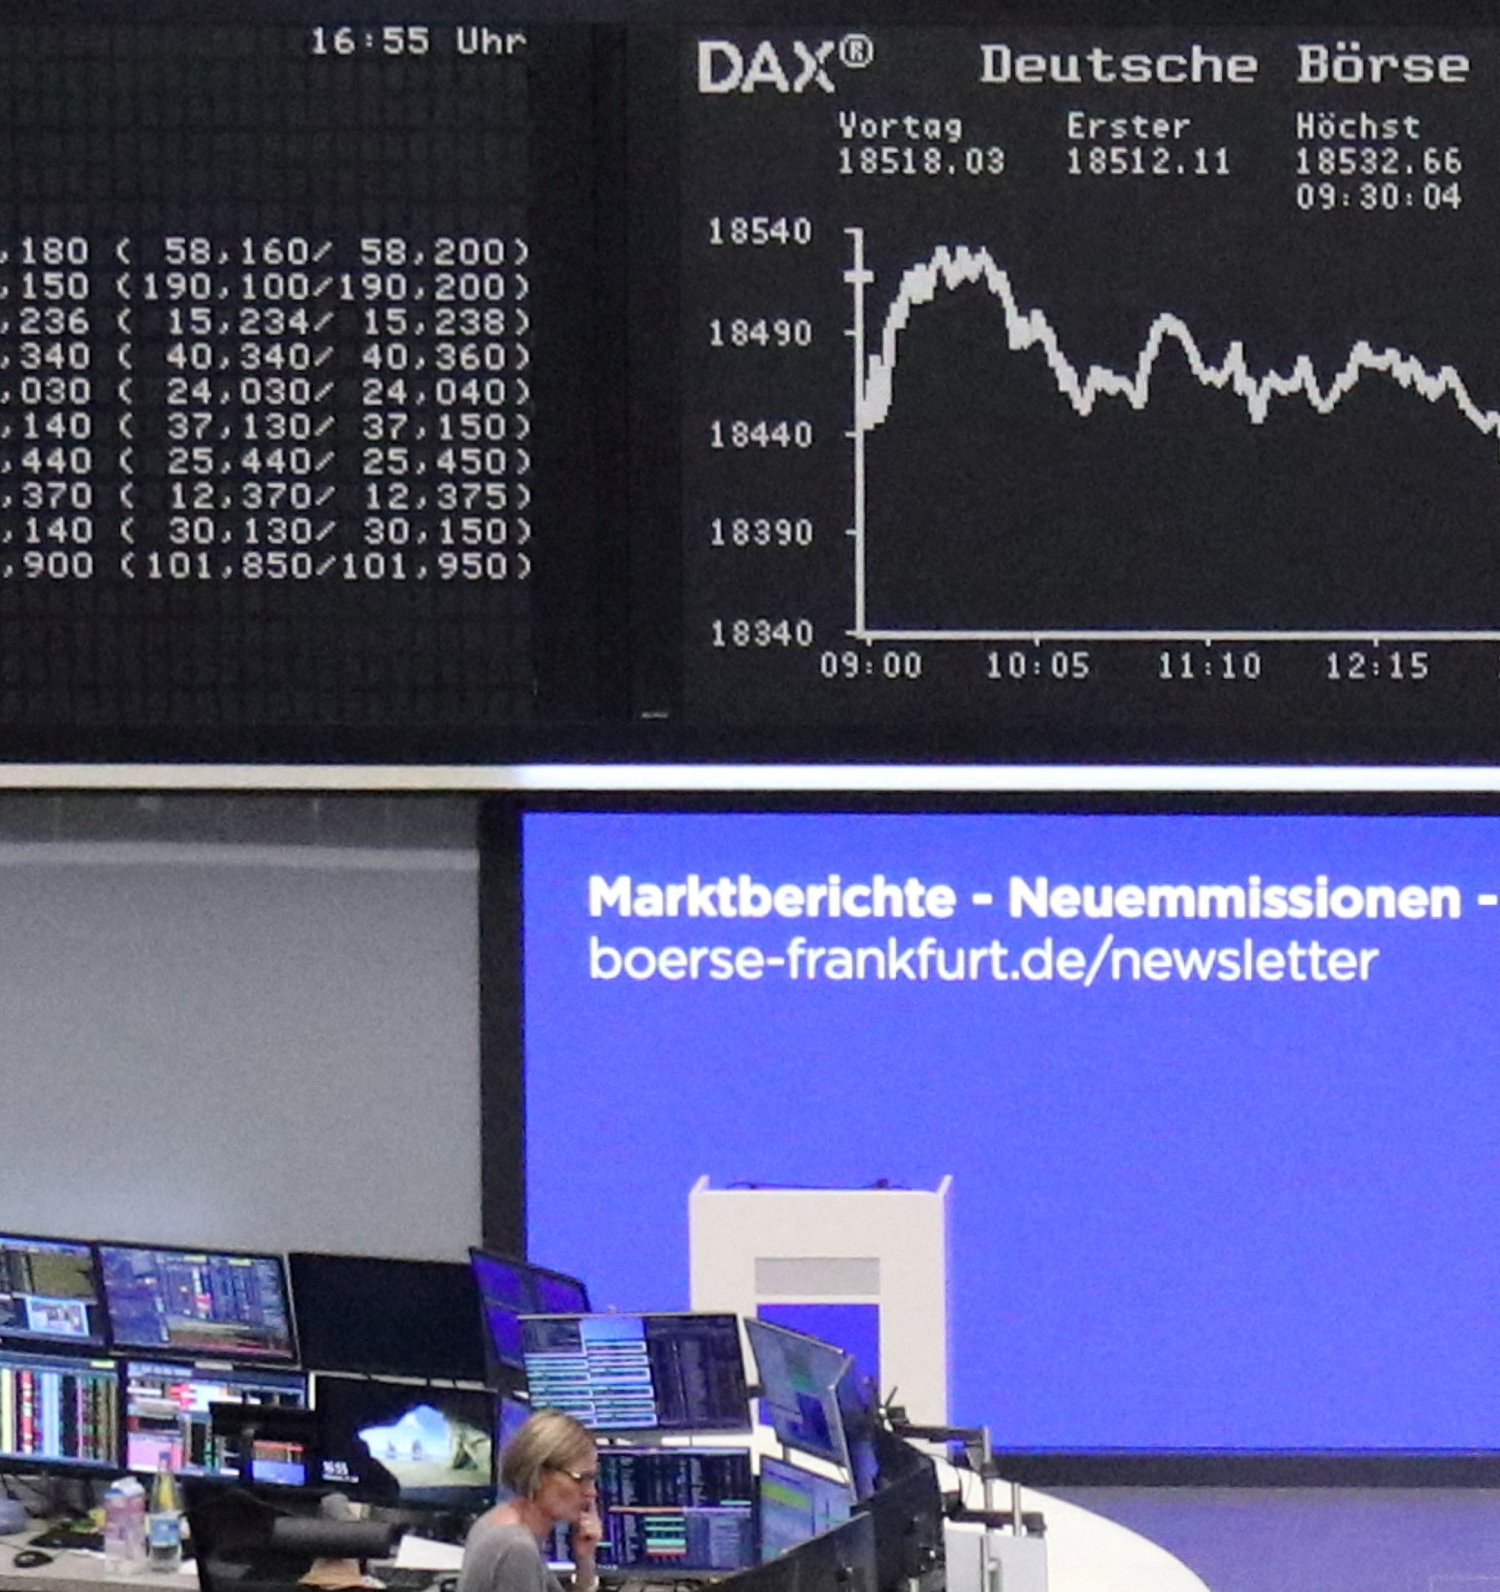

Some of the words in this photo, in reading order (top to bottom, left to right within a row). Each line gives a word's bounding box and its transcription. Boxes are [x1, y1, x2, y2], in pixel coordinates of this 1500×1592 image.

[312, 25, 430, 56] 16:55
[455, 25, 528, 56] Uhr
[979, 43, 1259, 84] Deutsche
[1296, 39, 1471, 84] Börse
[838, 110, 963, 144] Vortag
[1066, 110, 1192, 140] Erster
[1296, 110, 1421, 141] Höchst
[839, 145, 1005, 176] 18518.03
[1067, 145, 1230, 176] 18512.11
[1296, 145, 1463, 176] 18532.66
[1295, 181, 1463, 211] 09:30:04
[709, 215, 812, 246] 18540
[710, 317, 813, 348] 18490
[710, 419, 813, 449] 18440
[711, 517, 814, 547] 18390
[711, 618, 814, 648] 18340
[820, 650, 922, 680] 09:00
[987, 650, 1090, 679] 10:05
[1159, 651, 1262, 680] 11:10
[1327, 650, 1429, 680] 12:15
[587, 872, 959, 920] Marktberichte
[1007, 873, 1463, 921] Neuemmissionen
[588, 932, 1381, 989] boerse-frankfurt.de/newsletter
